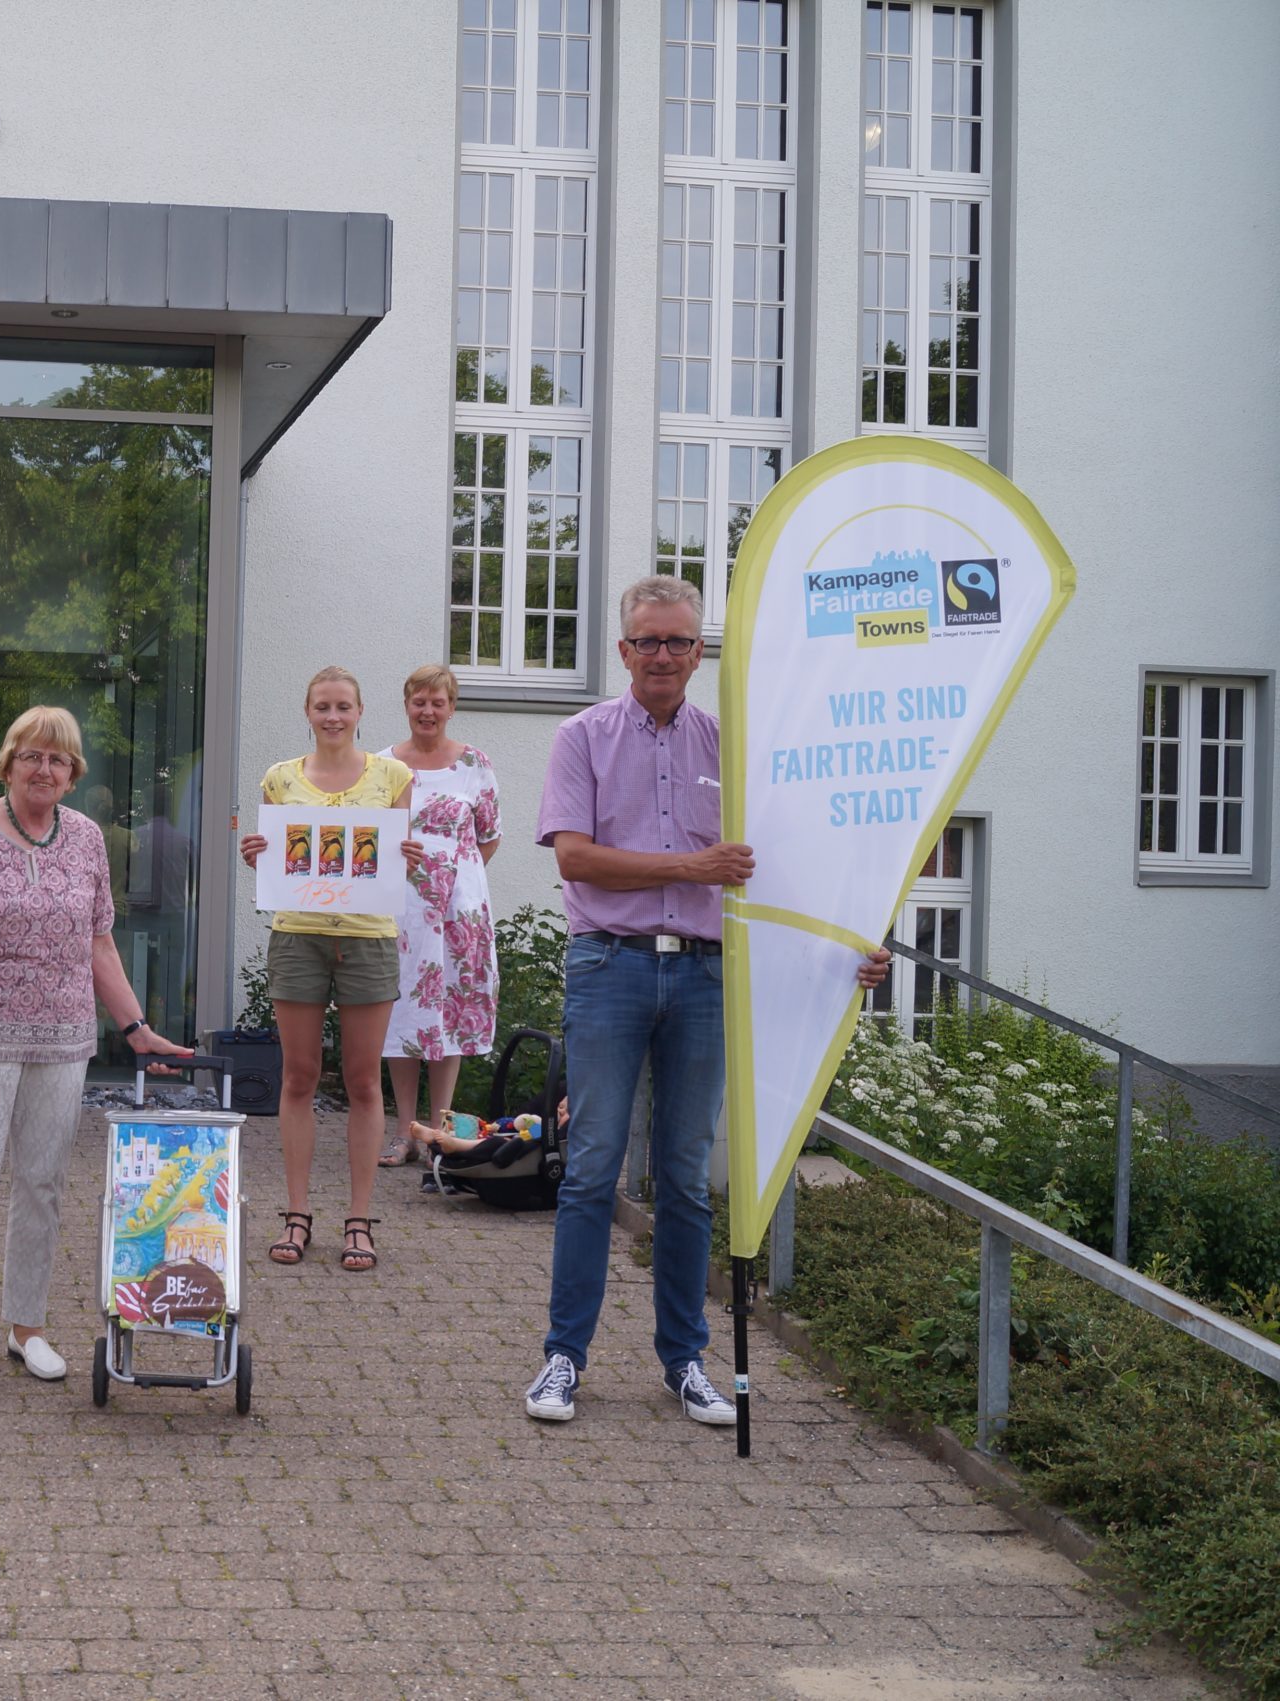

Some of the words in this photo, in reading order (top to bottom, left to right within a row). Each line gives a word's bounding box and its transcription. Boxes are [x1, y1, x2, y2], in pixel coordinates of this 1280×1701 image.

[808, 569, 919, 591] Kampagne
[810, 585, 933, 616] Fairtrade
[858, 620, 925, 638] Towns
[947, 612, 998, 623] FAIRTRADE
[828, 690, 886, 728] WIR
[897, 685, 967, 722] SIND
[771, 736, 949, 784] FAIRTRADE-
[829, 787, 922, 827] STADT
[293, 880, 353, 907] 175€
